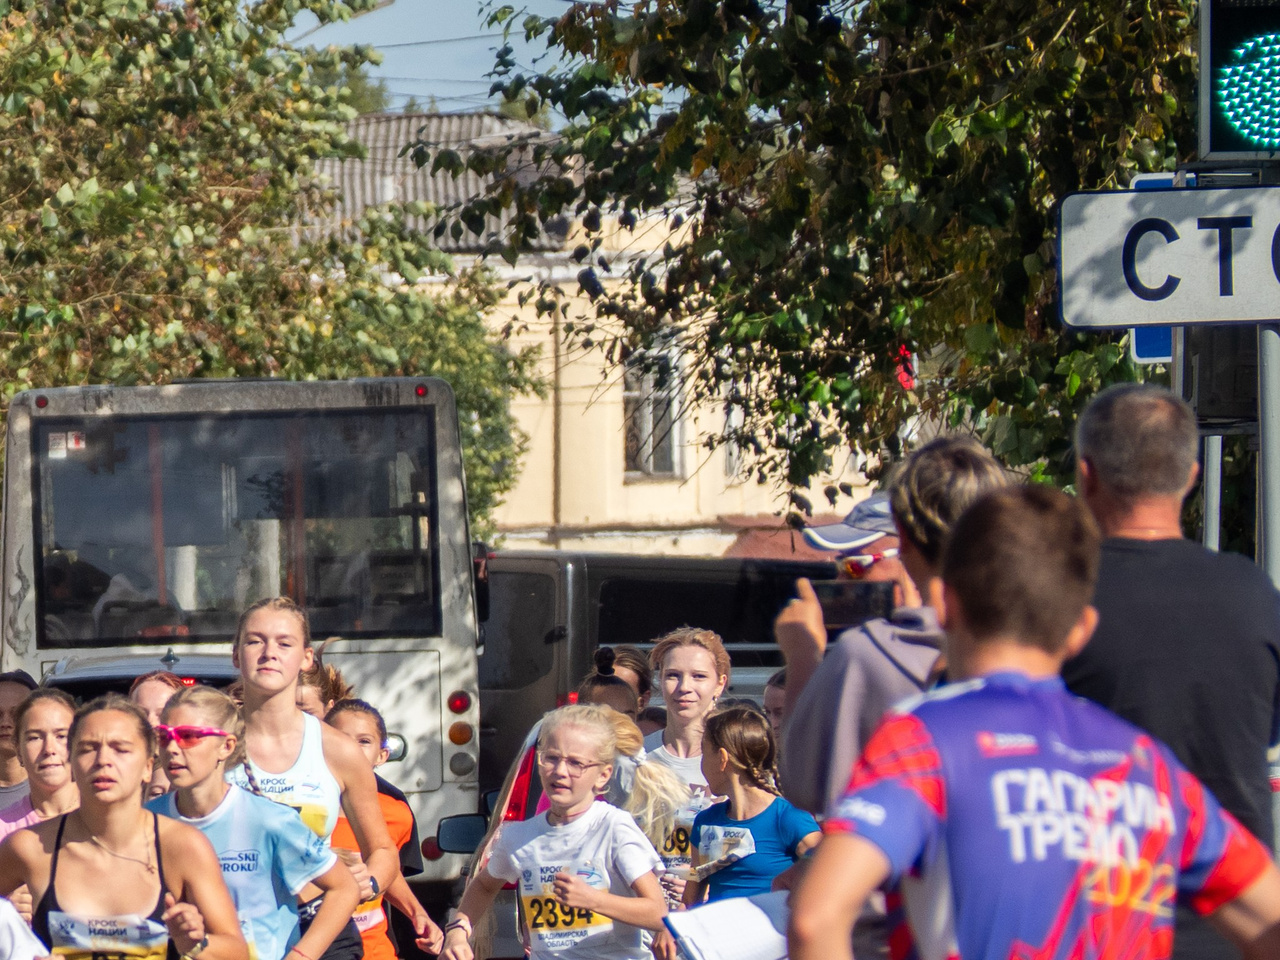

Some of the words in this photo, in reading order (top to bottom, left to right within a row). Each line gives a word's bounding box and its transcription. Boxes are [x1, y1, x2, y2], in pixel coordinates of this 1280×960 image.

[1122, 214, 1280, 302] СТ
[261, 778, 286, 786] КРОСС
[261, 785, 294, 794] НАЦИИ
[238, 852, 256, 862] SKI
[540, 866, 563, 874] КРОСС
[530, 897, 594, 929] 2394
[88, 928, 128, 936] НАЦИИ
[538, 930, 589, 941] ВЛАДИМИРСКАЯ
[547, 940, 579, 948] ОБЛАСТЬ
